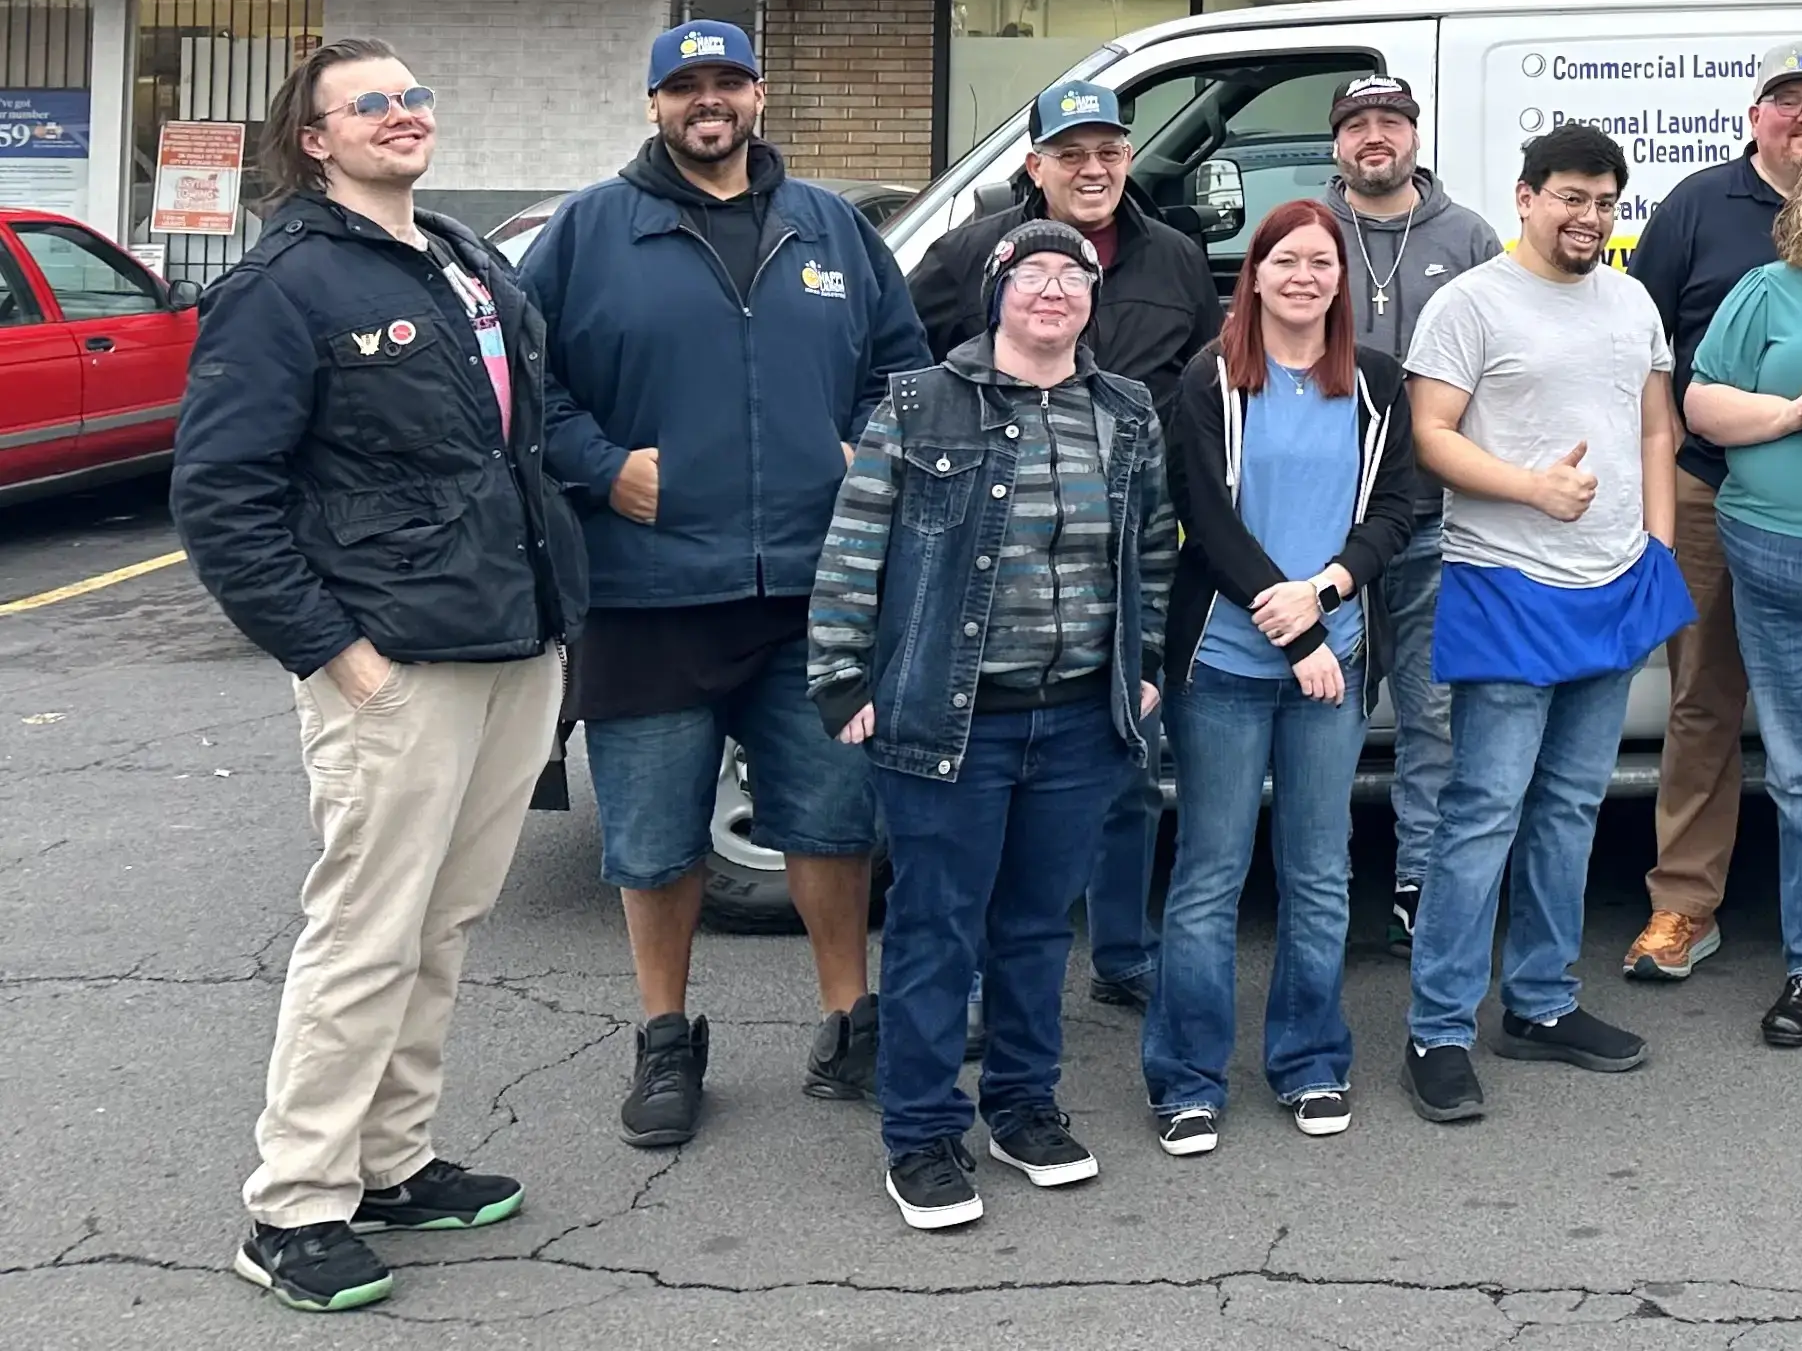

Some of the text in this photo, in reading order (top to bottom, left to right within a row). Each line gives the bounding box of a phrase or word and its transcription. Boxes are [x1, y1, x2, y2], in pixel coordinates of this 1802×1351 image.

[1553, 55, 1685, 80] Commercial
[9, 109, 51, 119] number
[1657, 109, 1743, 140] Laundry
[1633, 137, 1730, 163] Cleaning
